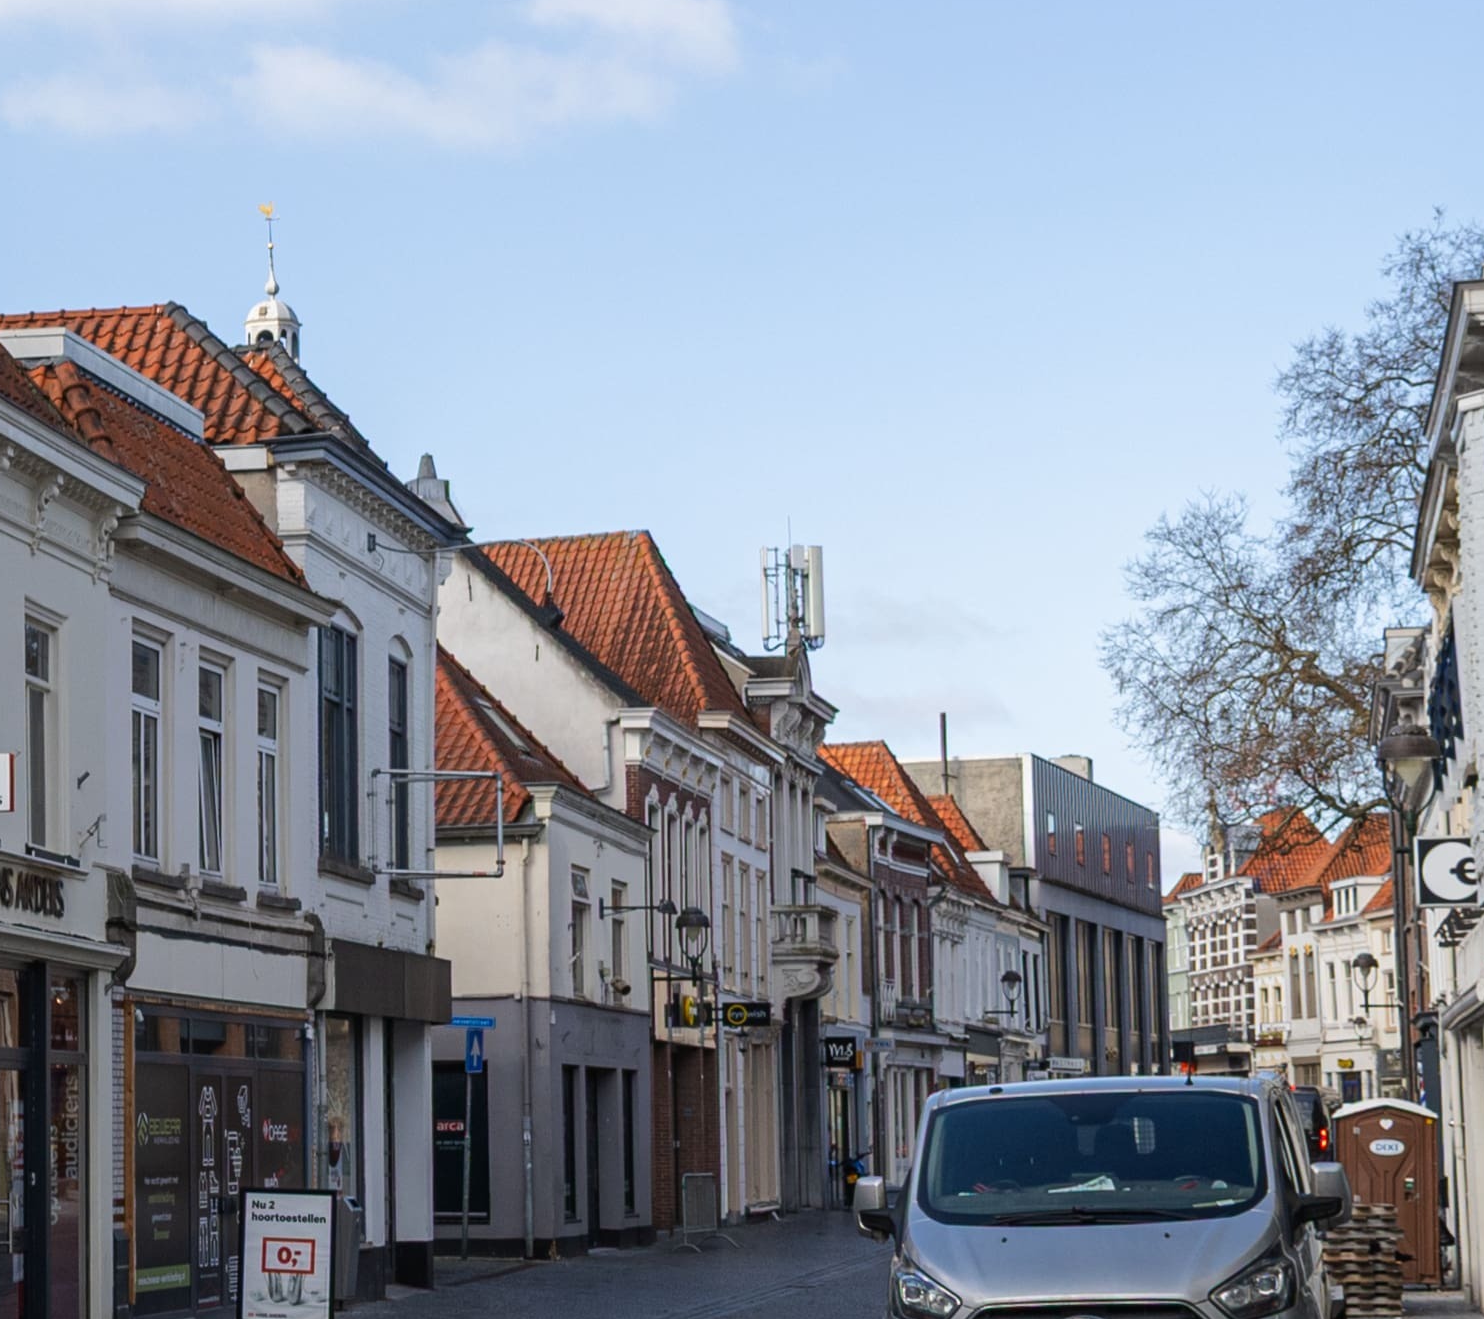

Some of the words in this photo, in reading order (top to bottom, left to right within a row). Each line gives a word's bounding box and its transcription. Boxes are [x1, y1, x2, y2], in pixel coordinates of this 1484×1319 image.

[15, 870, 65, 920] ANDERS
[60, 1075, 79, 1180] audiciens
[436, 1121, 465, 1132] arca
[252, 1200, 267, 1210] Nu
[268, 1200, 275, 1210] 2
[251, 1212, 327, 1224] hoortoestellen
